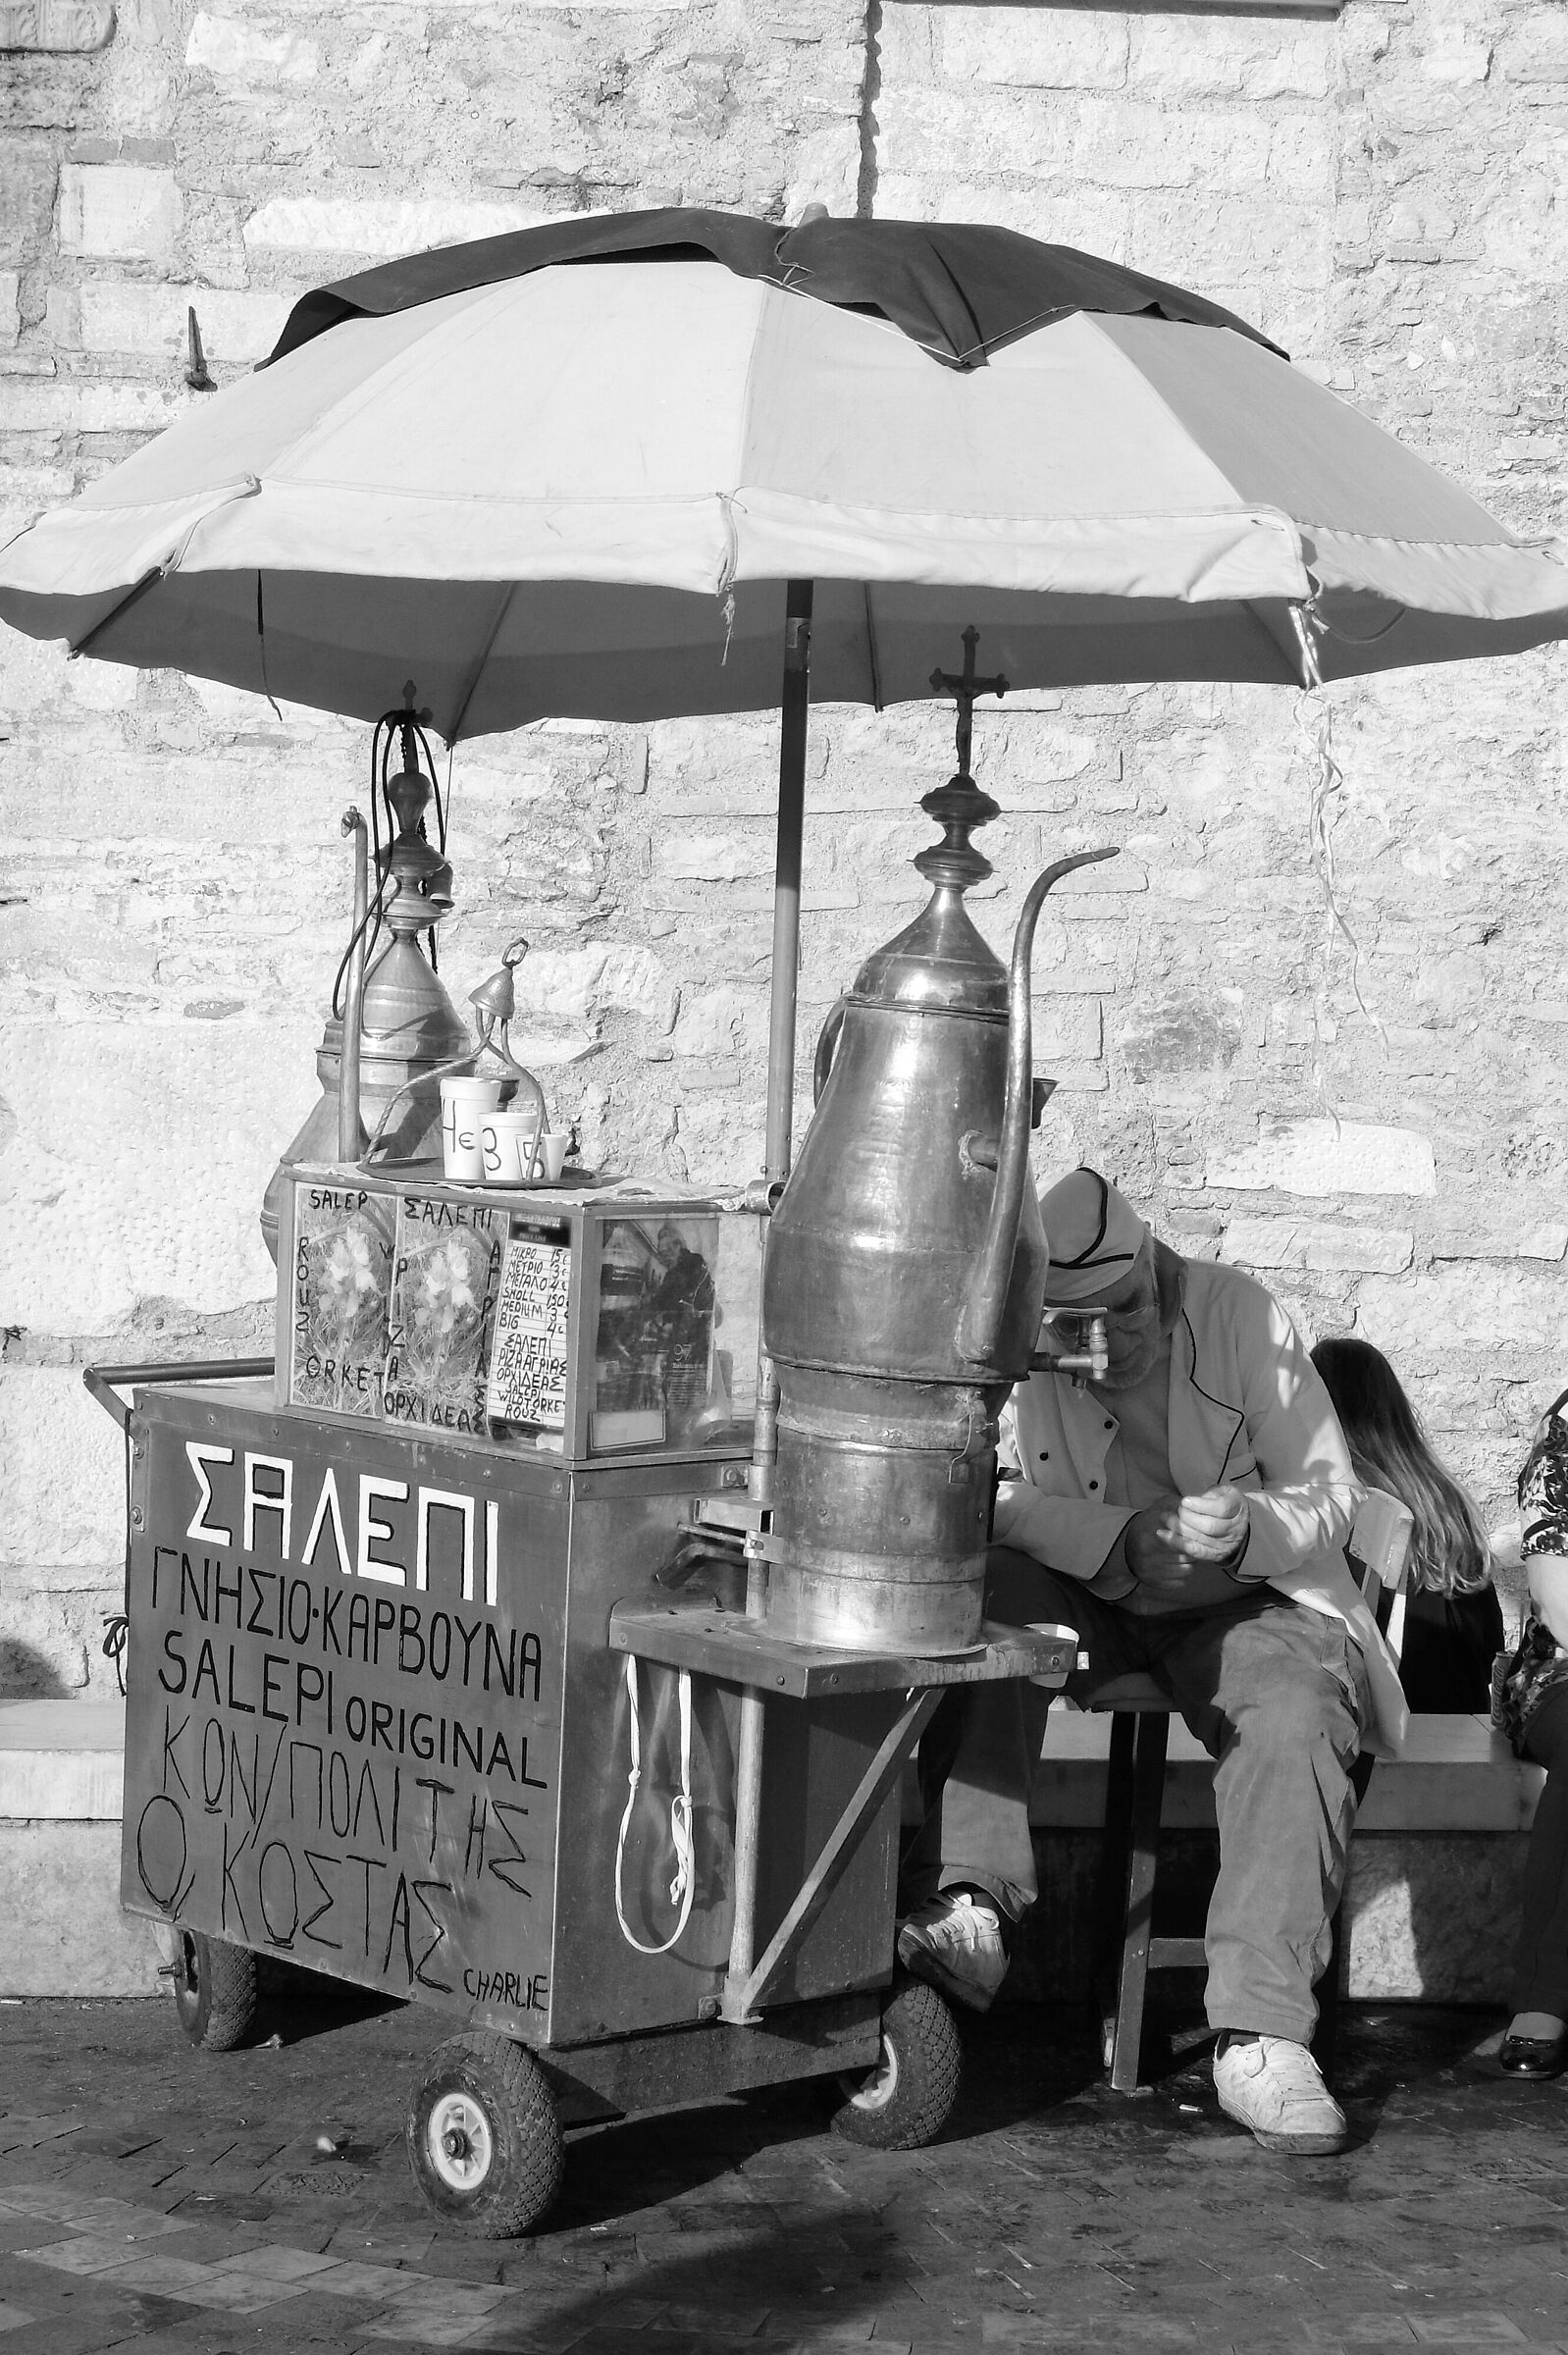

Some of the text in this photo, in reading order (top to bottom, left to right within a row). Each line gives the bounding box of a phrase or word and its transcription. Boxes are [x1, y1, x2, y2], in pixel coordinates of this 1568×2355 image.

[309, 1188, 369, 1210] SALEP
[403, 1196, 493, 1229] ΣΑΛΕΠΙ
[510, 1246, 537, 1260] ΜΙΚΡΟ
[507, 1260, 543, 1275] ΜΕΤΡΙΟ
[505, 1272, 548, 1291] ΜΕΓΑΛΟ
[498, 1312, 520, 1330] BIG
[500, 1299, 543, 1320] MEDIUM
[504, 1333, 551, 1358] ΣΑΛΕΠΙ
[305, 1354, 385, 1397] ORKET
[497, 1367, 564, 1391] ΟΡΧΙΔΕΑΣ
[184, 1440, 499, 1606] ΣΑΛΕΠΙ
[158, 1630, 549, 1789] SALEPI ORIGINAL
[222, 1822, 454, 1995] ΚΟΣΤΑΣ
[463, 1967, 549, 2012] CHARLIE
